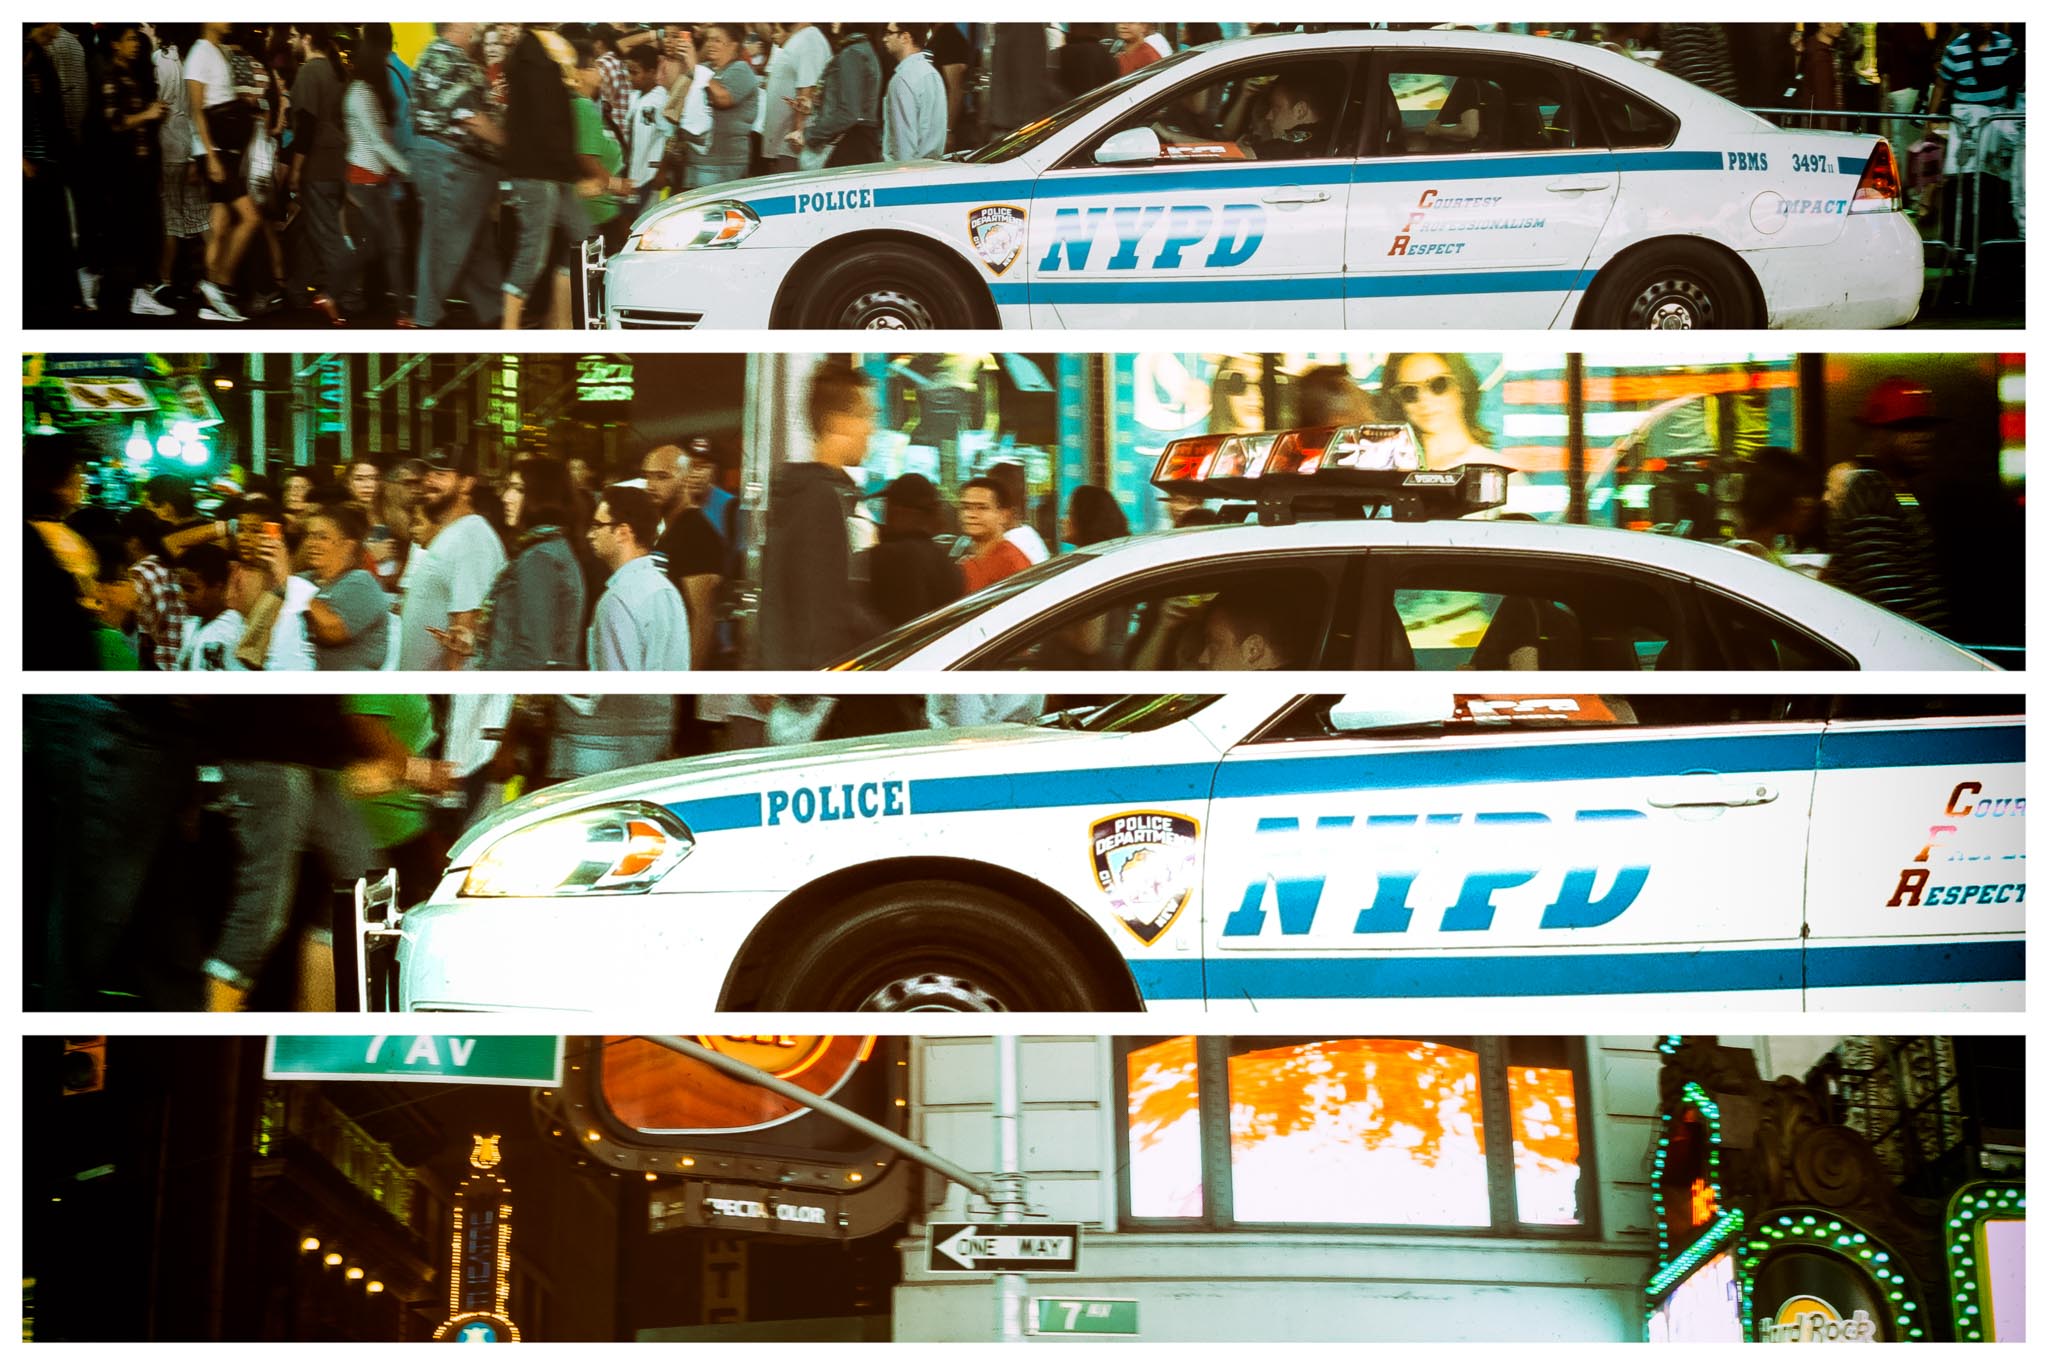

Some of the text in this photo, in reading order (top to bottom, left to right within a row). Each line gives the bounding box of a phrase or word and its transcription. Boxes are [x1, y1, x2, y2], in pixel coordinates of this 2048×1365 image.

[1727, 151, 1768, 172] PBMS
[1792, 153, 1827, 174] 3497
[798, 188, 871, 213] POLICE
[981, 207, 1013, 217] POLICE
[1776, 199, 1847, 215] IMPACT
[1039, 204, 1266, 271] NYPD
[1387, 235, 1466, 257] RESPECT
[766, 780, 904, 826] POLICE
[1114, 815, 1173, 833] POLICE
[1222, 809, 1653, 937] NYPD
[956, 1238, 1064, 1258] ONE WAY
[1059, 1302, 1083, 1330] 7
